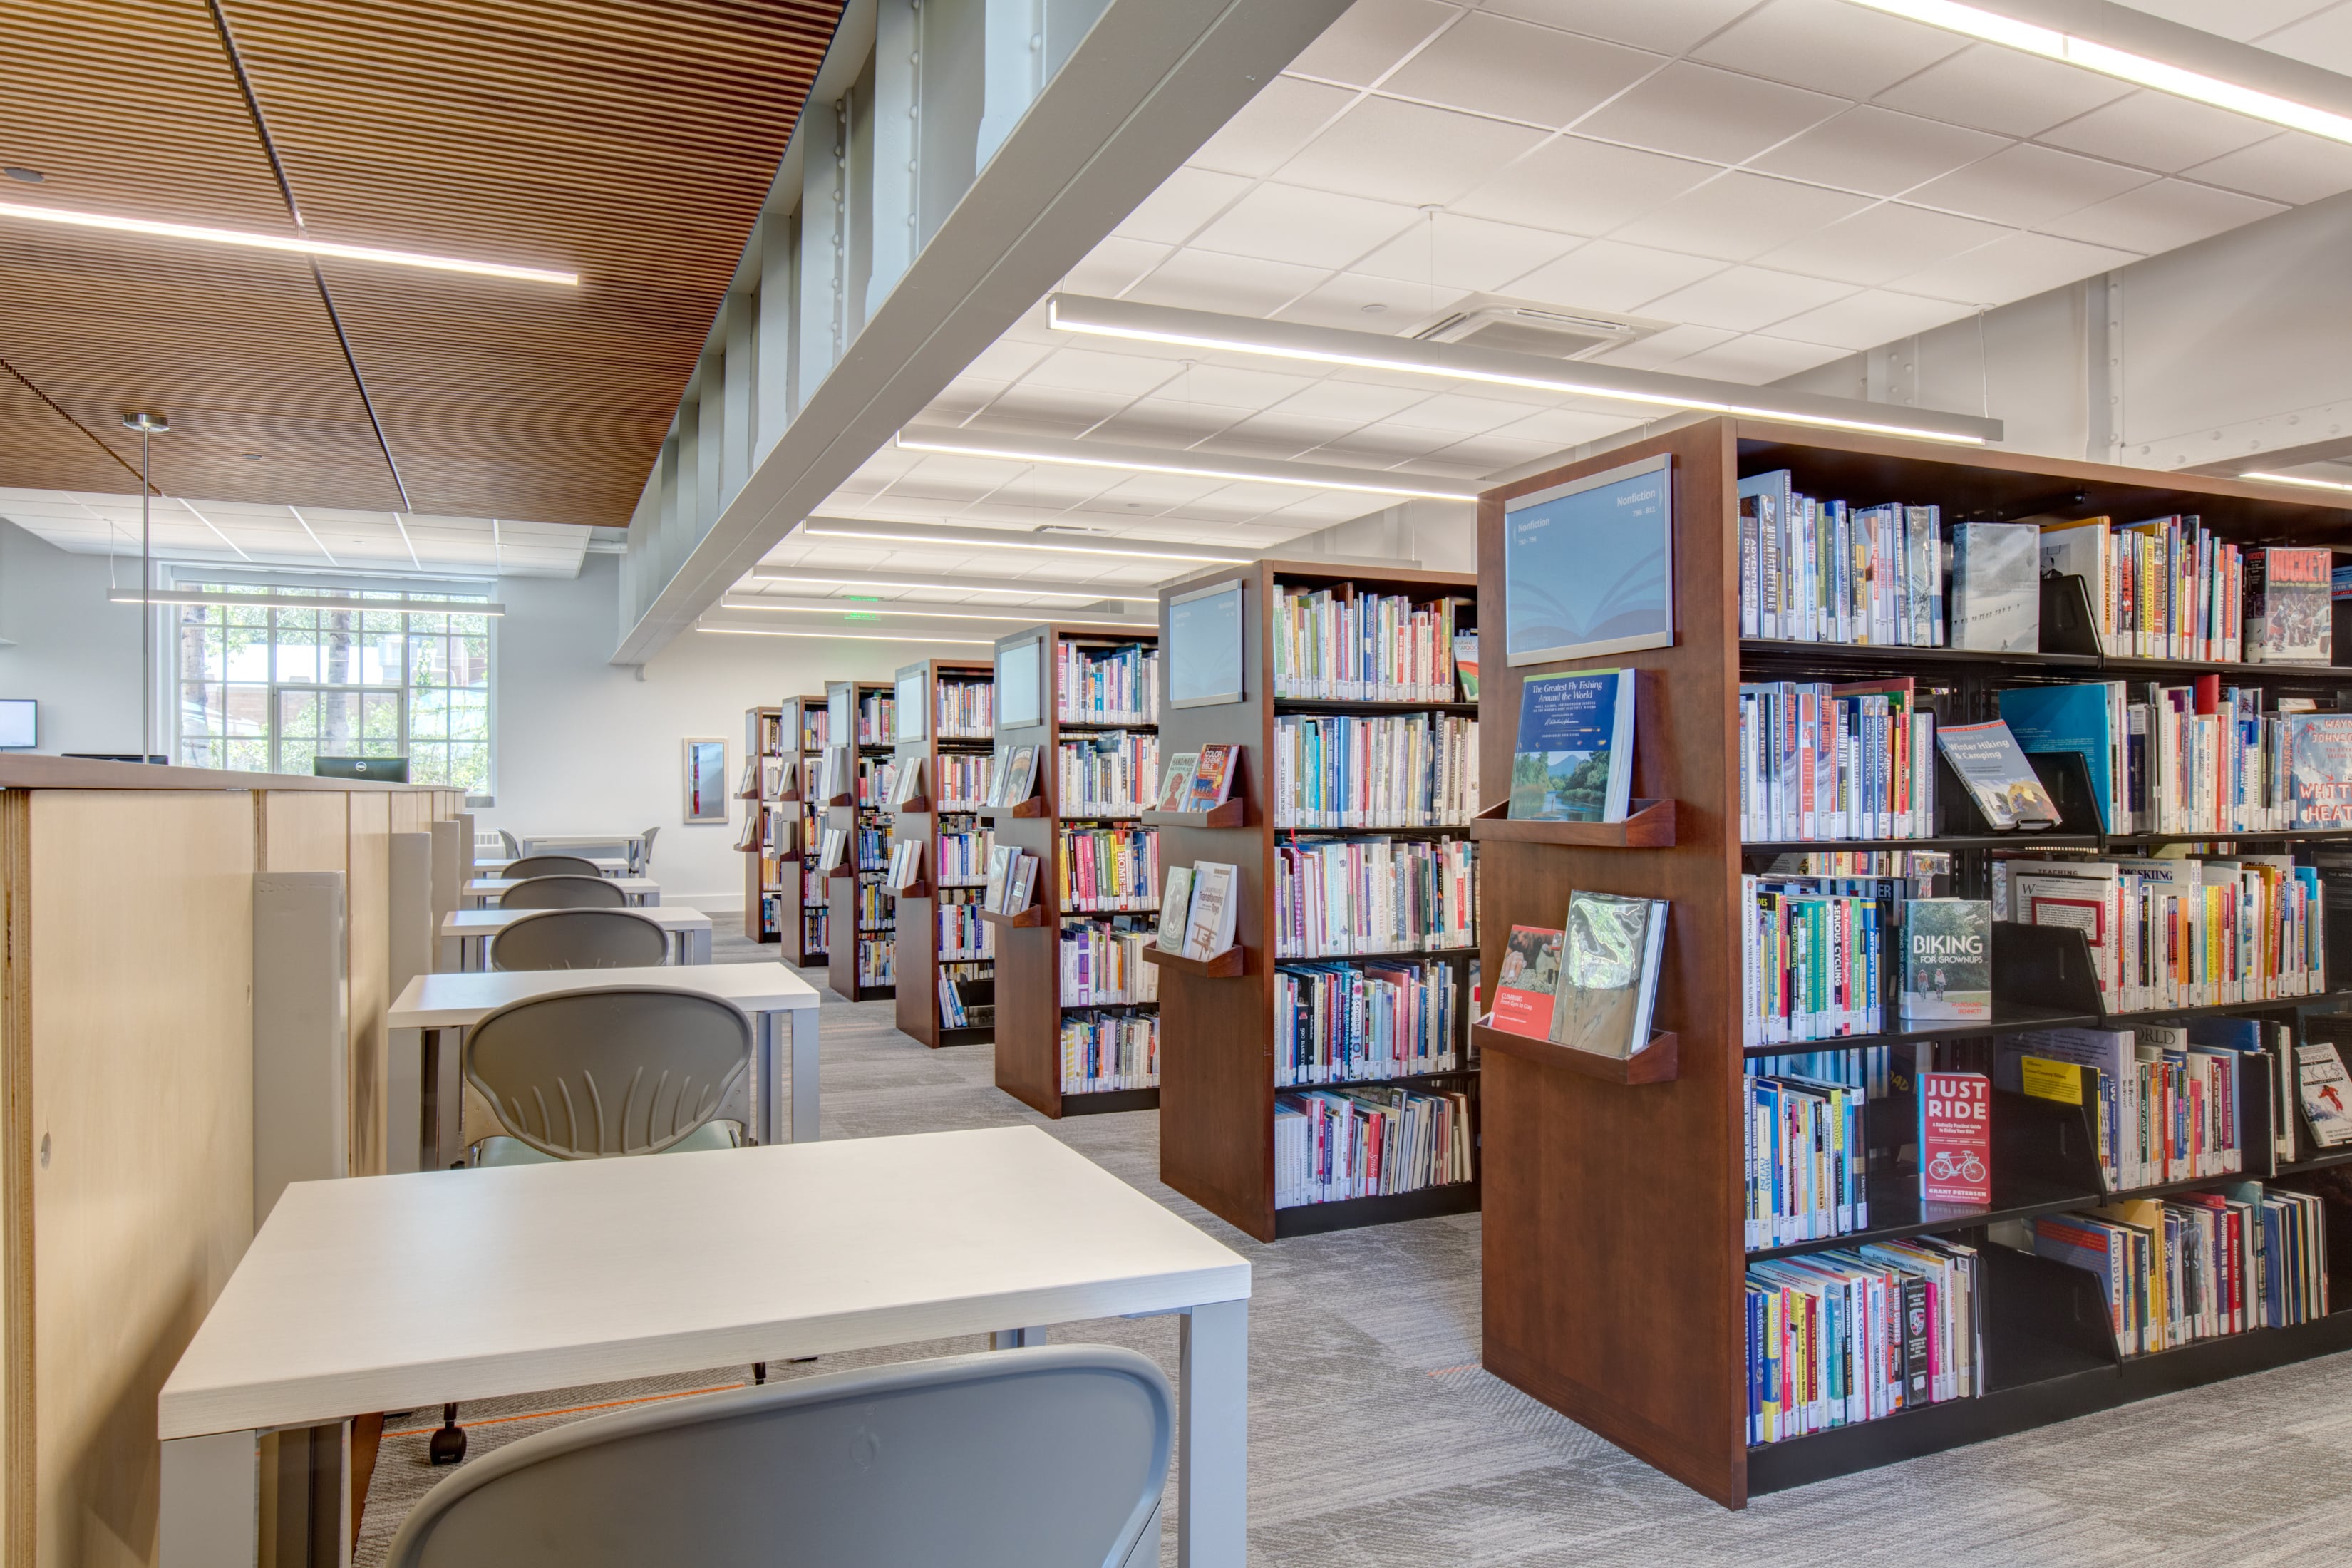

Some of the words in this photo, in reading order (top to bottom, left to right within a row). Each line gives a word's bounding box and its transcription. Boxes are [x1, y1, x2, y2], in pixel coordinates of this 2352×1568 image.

[1617, 490, 1656, 507] Nonfiction
[1518, 517, 1550, 533] Nonfiction
[1745, 538, 1750, 553] ON
[1767, 525, 1776, 609] MOUNTAINEERING
[2269, 550, 2331, 582] HOCKEY!
[1533, 685, 1542, 693] The
[1544, 684, 1567, 692] Greatest
[1569, 681, 1577, 690] Fly
[1579, 680, 1602, 691] Fishing
[1539, 693, 1560, 702] Around
[1574, 691, 1592, 700] World
[1787, 694, 1796, 722] Fallen
[1822, 695, 1831, 722] Fallen
[2324, 719, 2352, 728] WAYN
[1788, 724, 1796, 752] Giants
[1822, 725, 1830, 752] Giants
[1839, 726, 1848, 767] MOUNTAIN
[1947, 742, 1976, 751] Winter
[1979, 739, 2010, 750] Hiking
[2312, 733, 2352, 743] JOHNSO
[1954, 751, 1961, 760] &
[1963, 751, 2002, 760] Camping
[2299, 783, 2352, 800] WHIT
[2307, 805, 2352, 822] HEAT
[1912, 935, 1983, 954] BIKING
[1938, 956, 1983, 964] GROWNUPS
[1928, 1080, 1986, 1099] JUST
[1928, 1100, 1986, 1120] RIDE
[1773, 1299, 1779, 1309] 23
